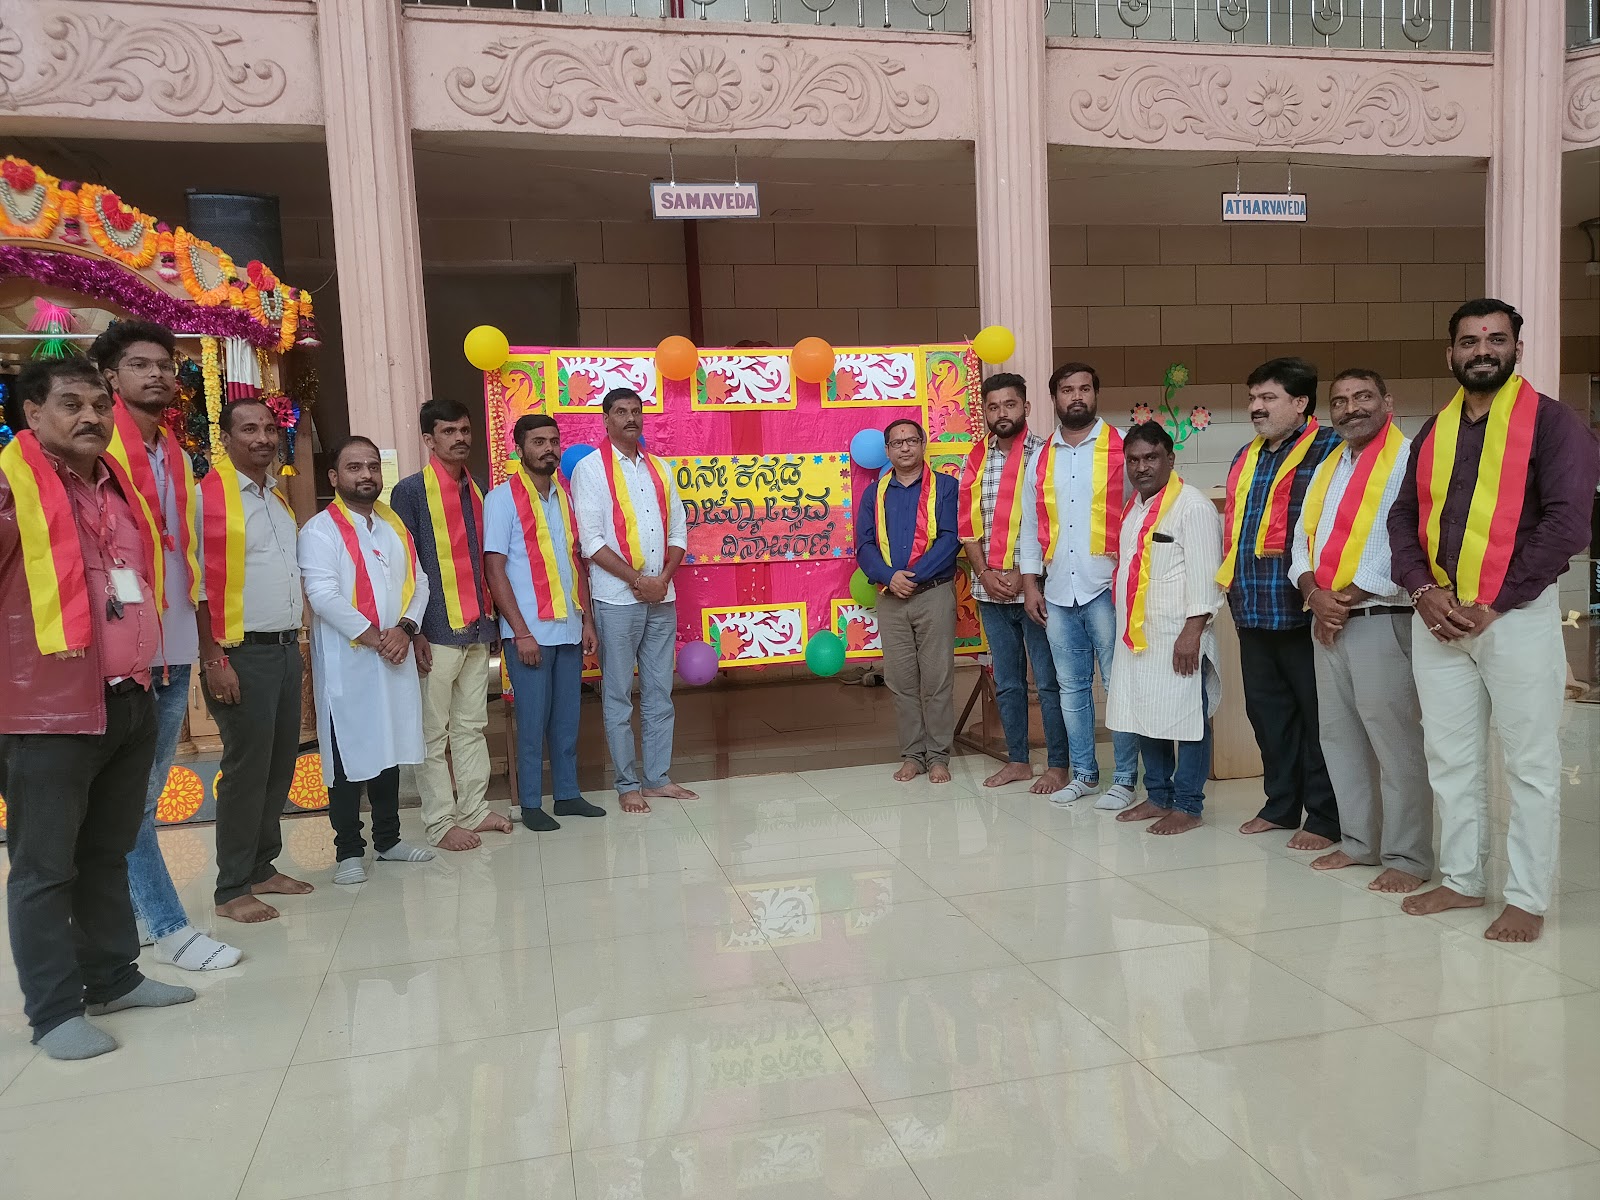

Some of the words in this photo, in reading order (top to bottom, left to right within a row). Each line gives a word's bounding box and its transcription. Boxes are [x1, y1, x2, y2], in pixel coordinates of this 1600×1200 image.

[661, 192, 756, 210] SAMAVEDA
[1225, 199, 1306, 216] ATHARVAVEDA
[733, 455, 806, 492] ಕನ್ನಡ
[720, 521, 836, 561] ದಿನಾಚರಣೆ
